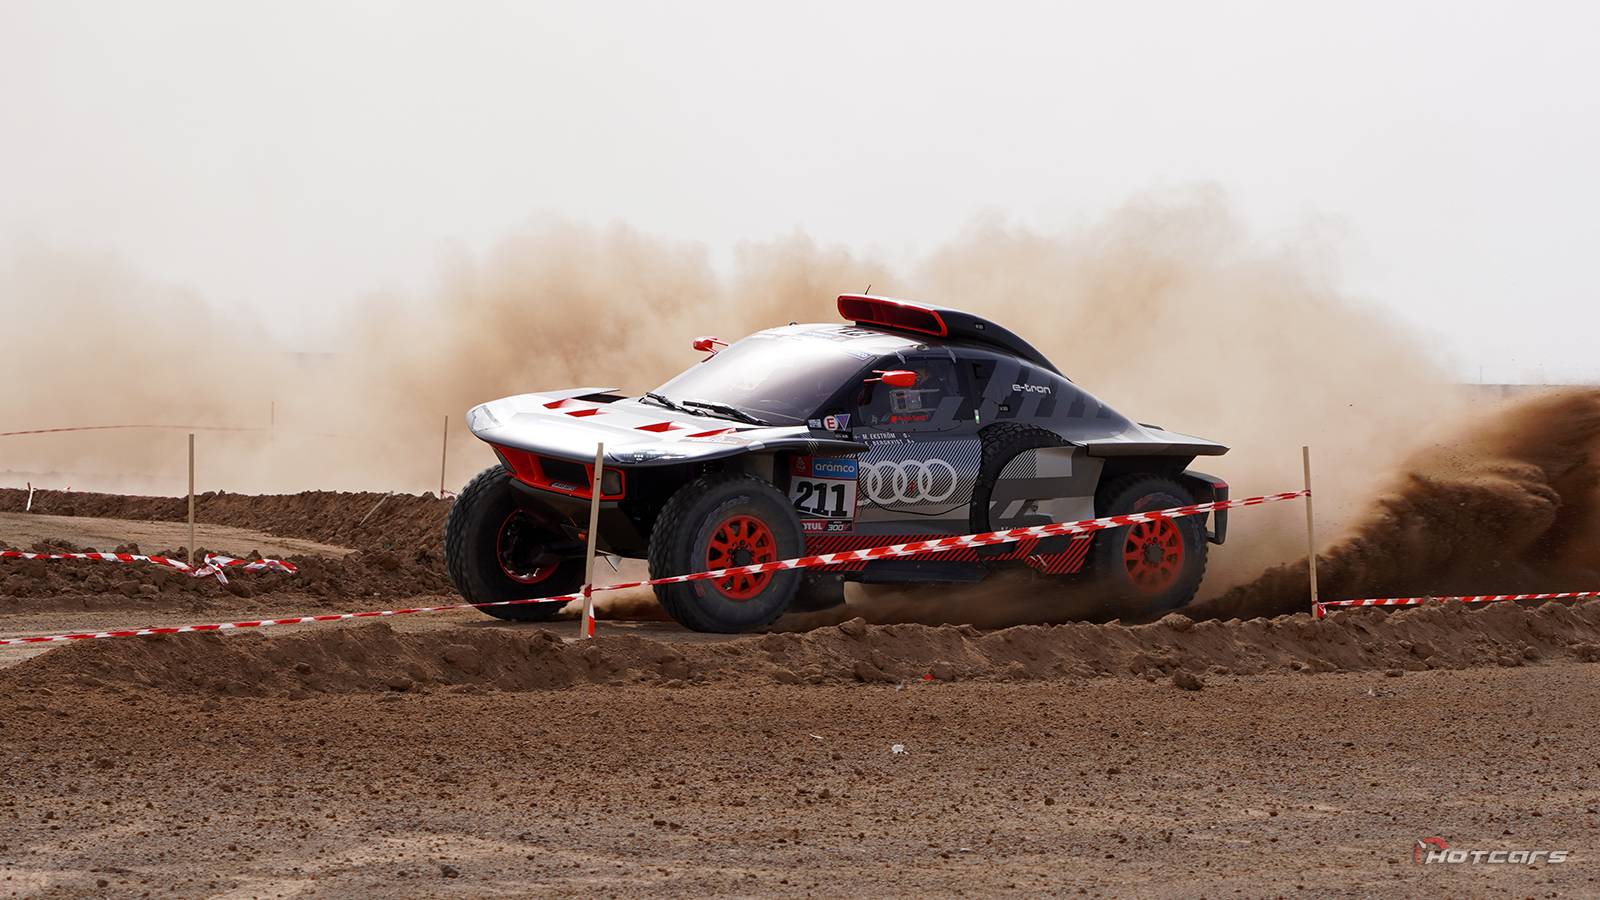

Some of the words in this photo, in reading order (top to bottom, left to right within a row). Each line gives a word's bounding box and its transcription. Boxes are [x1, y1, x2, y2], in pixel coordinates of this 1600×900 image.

[1011, 383, 1052, 394] e-tron
[826, 417, 835, 429] E
[815, 462, 855, 473] aramco
[793, 481, 848, 517] 211
[801, 522, 823, 530] TUL
